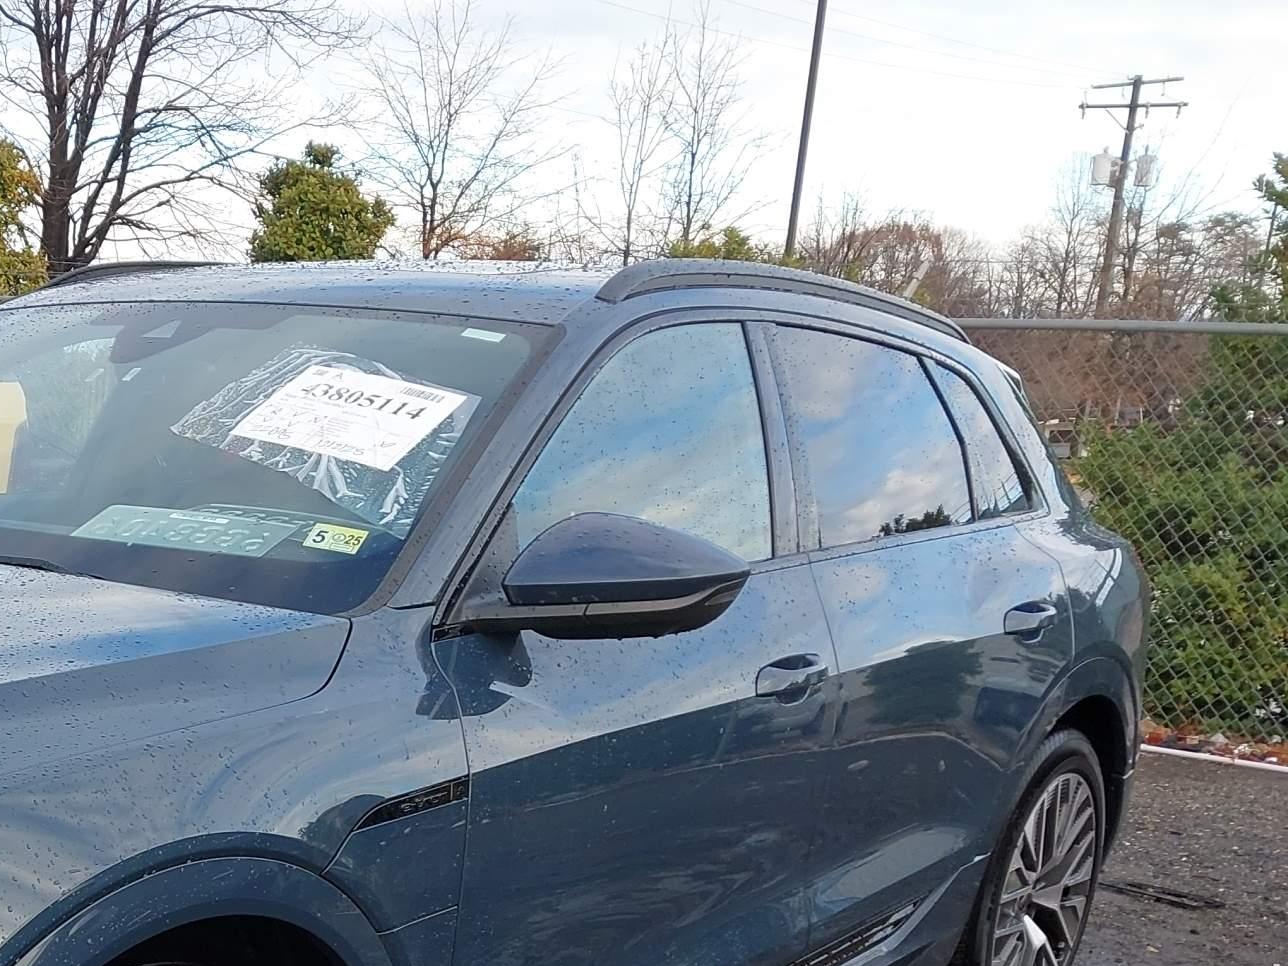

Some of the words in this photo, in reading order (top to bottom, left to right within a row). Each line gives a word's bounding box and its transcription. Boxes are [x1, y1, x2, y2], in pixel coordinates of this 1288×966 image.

[300, 383, 429, 420] 43805114
[312, 530, 329, 544] 5
[344, 534, 363, 546] 25
